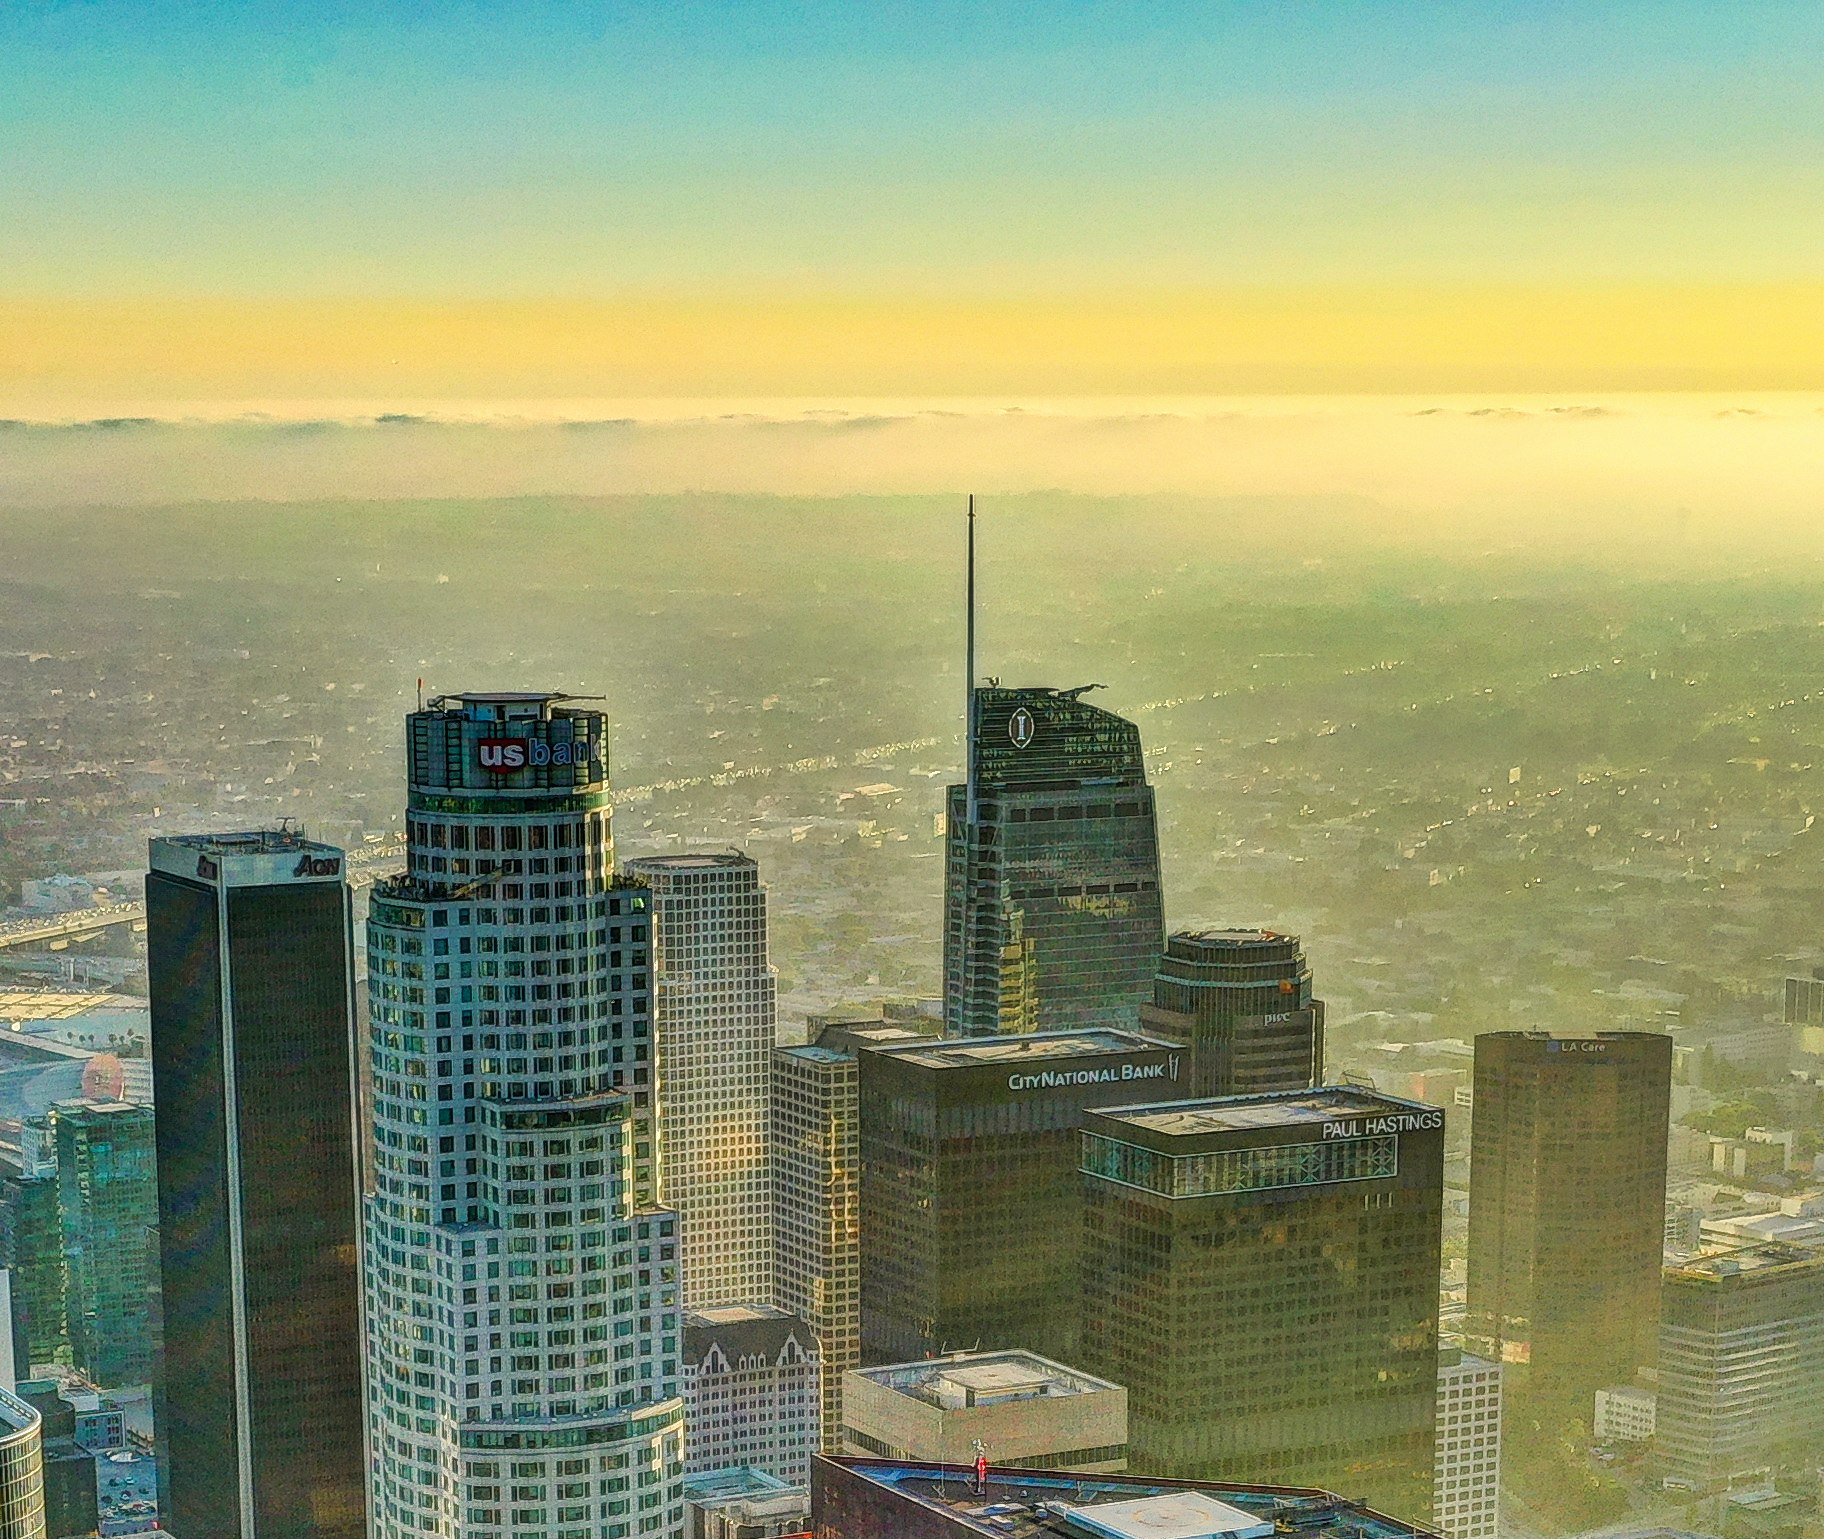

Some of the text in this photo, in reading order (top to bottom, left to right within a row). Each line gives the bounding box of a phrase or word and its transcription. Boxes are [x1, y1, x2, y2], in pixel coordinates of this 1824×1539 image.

[1264, 1012, 1291, 1027] pwc
[1008, 1063, 1165, 1090] CITY NATIONAL BANK
[1322, 1112, 1442, 1140] PAUL HASTINGS
